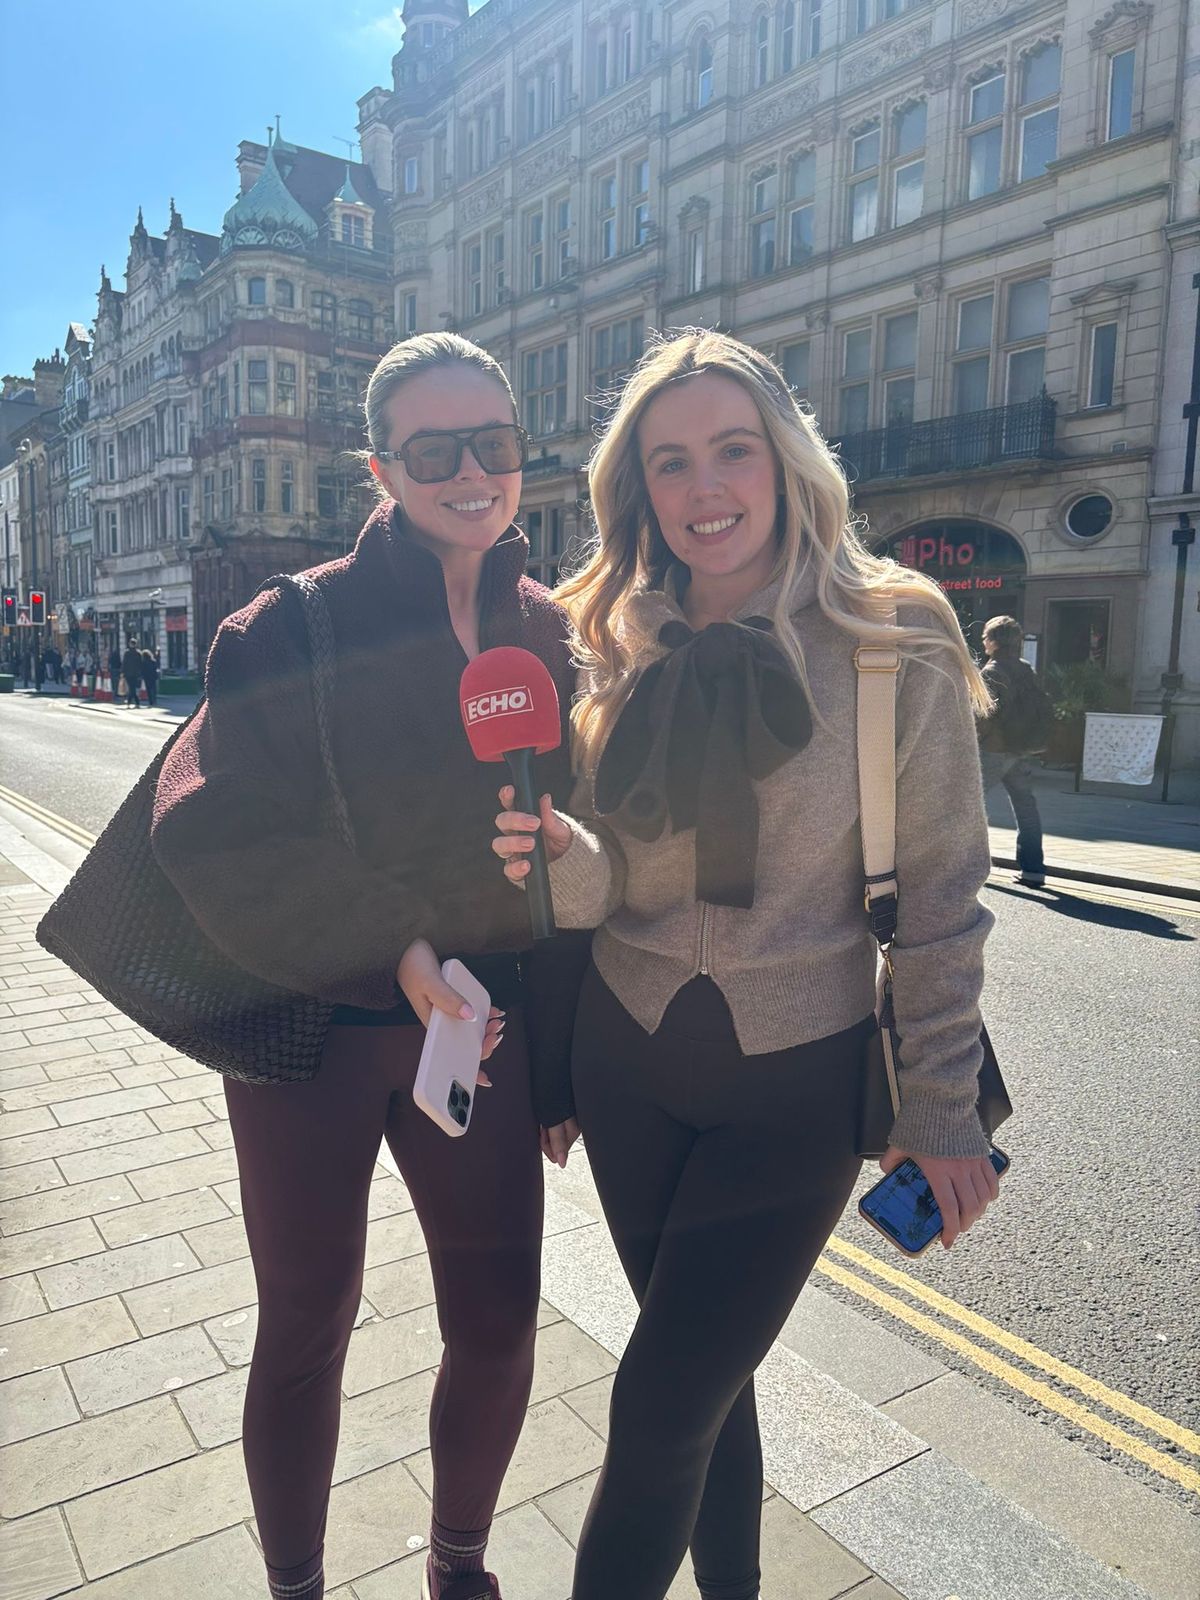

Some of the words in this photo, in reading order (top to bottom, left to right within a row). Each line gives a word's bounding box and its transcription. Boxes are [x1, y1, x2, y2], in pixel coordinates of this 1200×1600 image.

[919, 538, 974, 567] Pho
[975, 576, 1002, 589] food
[467, 691, 527, 721] ECHO
